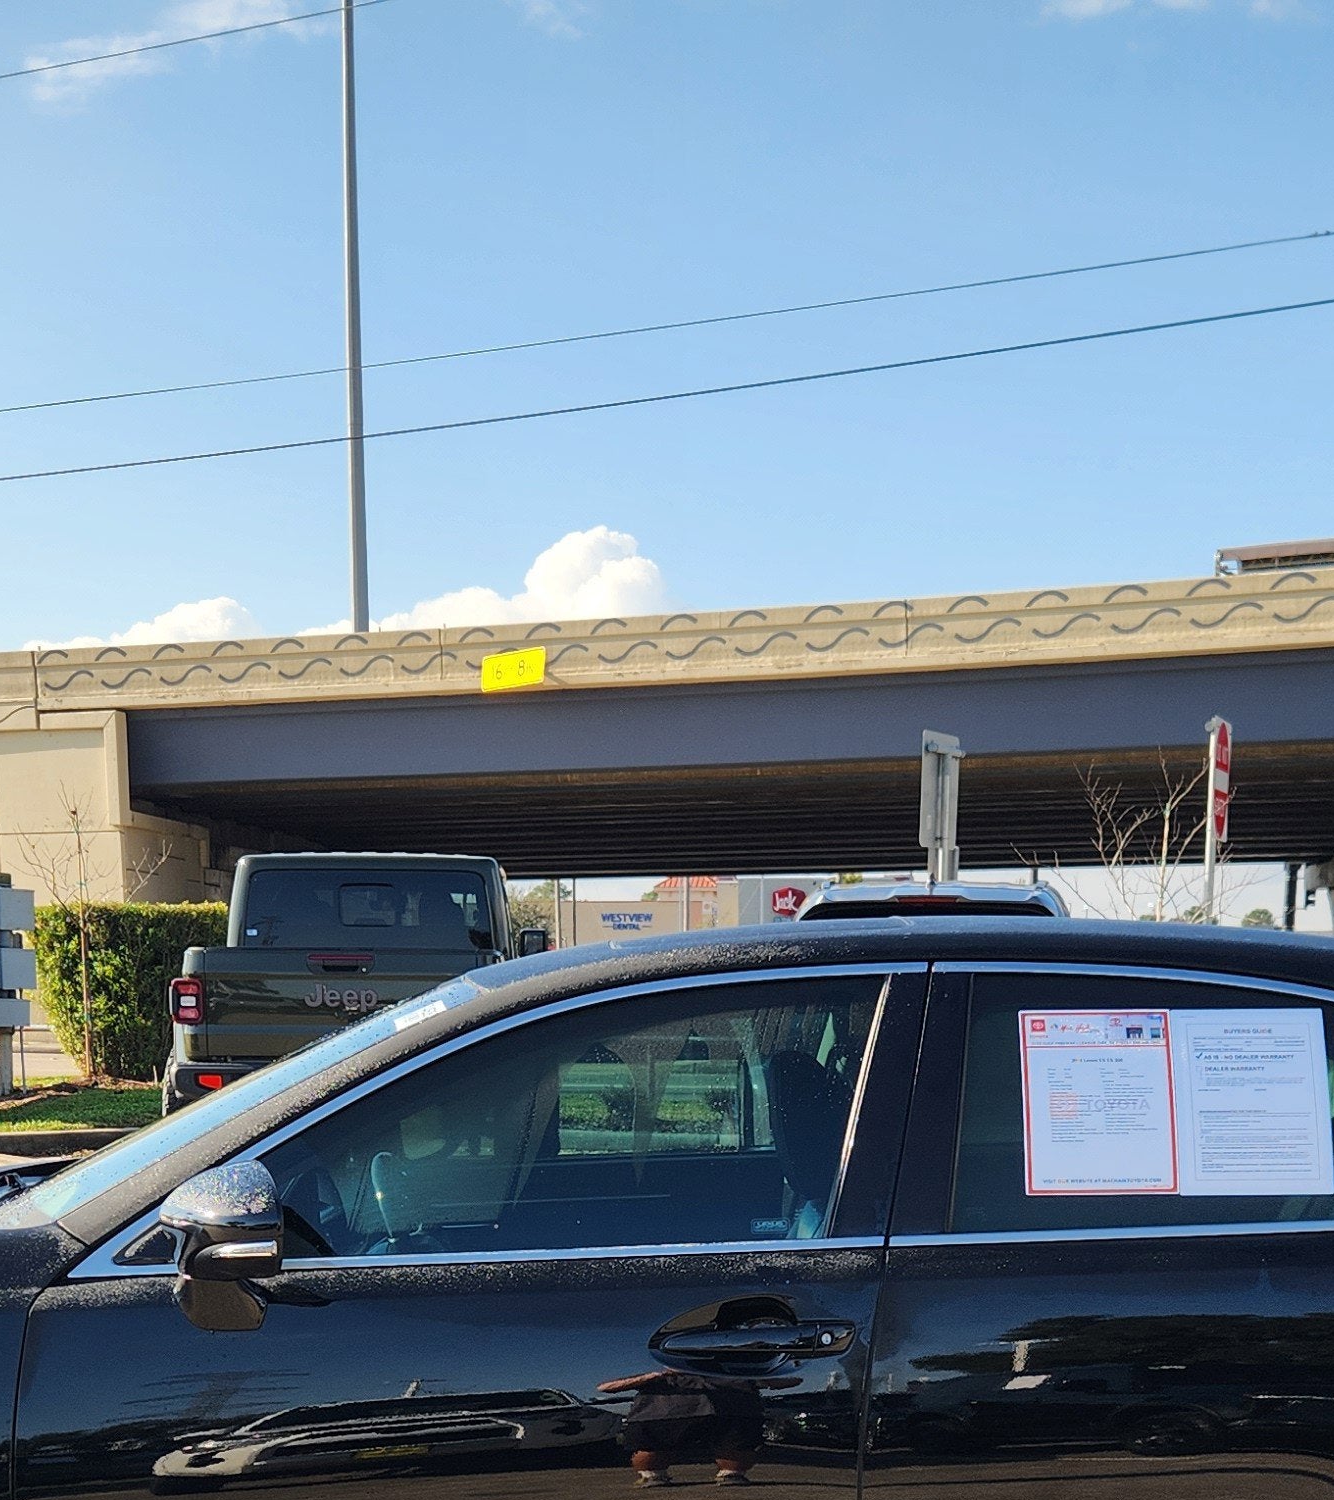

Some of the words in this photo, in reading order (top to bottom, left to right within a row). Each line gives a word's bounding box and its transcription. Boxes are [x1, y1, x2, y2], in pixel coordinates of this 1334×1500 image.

[772, 889, 798, 912] Jack
[600, 912, 653, 923] WESTVIEW
[612, 922, 642, 931] DENTAL
[304, 983, 379, 1013] Jeep
[1085, 1098, 1151, 1112] TOYOTA
